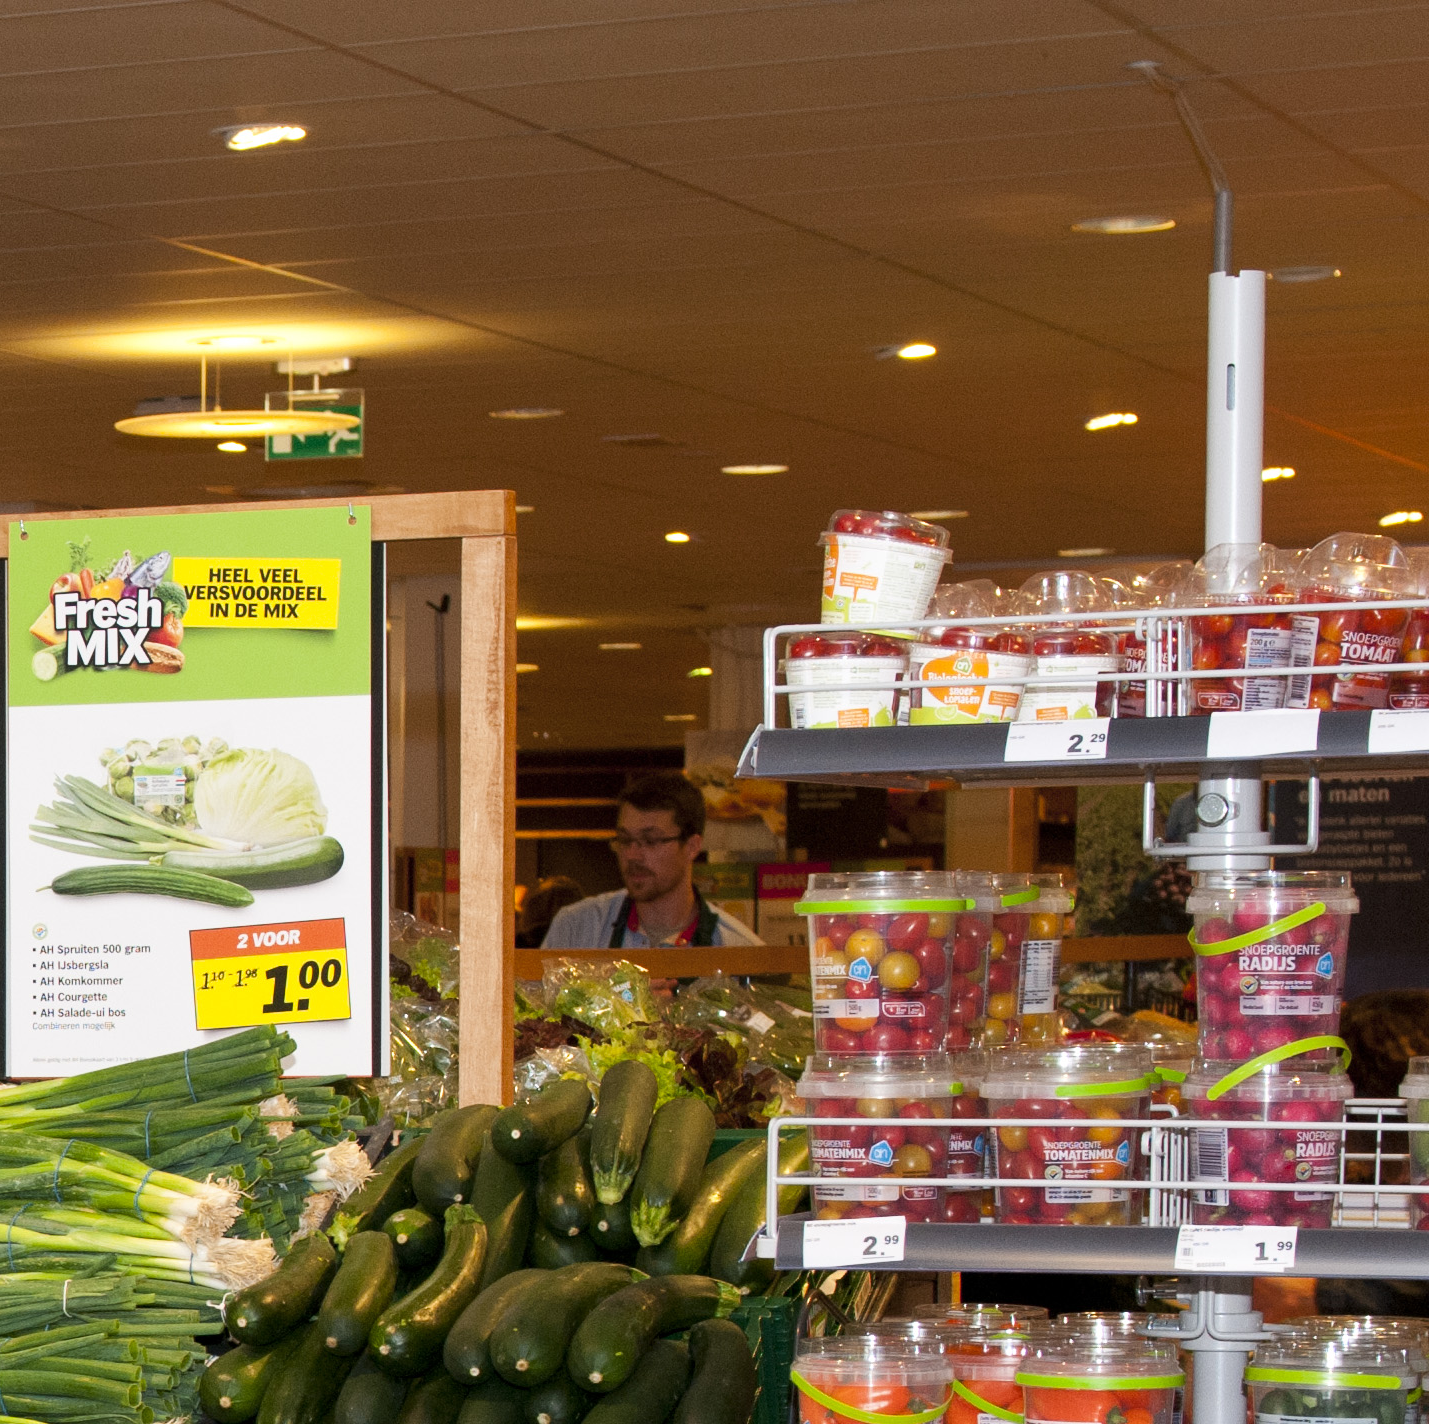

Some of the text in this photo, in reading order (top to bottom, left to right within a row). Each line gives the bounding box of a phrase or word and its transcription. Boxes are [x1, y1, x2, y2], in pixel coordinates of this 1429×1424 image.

[208, 568, 304, 583] HEEL VEEL
[184, 585, 327, 602] VERSVOORDEEL
[54, 588, 163, 630] Fresh
[209, 602, 299, 619] IN DE MIX
[67, 628, 153, 666] MIX
[1340, 642, 1397, 663] TOMAAT
[1067, 733, 1106, 753] 2.29
[1329, 786, 1390, 803] maten
[236, 929, 301, 949] 2 VOOR
[40, 944, 151, 956] AH Spruiten 500 gram
[1238, 944, 1321, 955] SNOEPGROENTE
[40, 960, 109, 971] AH IJsbergsla
[1238, 956, 1296, 971] RADIJS
[40, 976, 123, 986] AH Komkommer
[262, 958, 342, 1014] 1.00
[40, 991, 107, 1003] AH Courgette
[40, 1007, 126, 1017] AH Salade-ui bos
[32, 1022, 80, 1030] Combineren
[1043, 1149, 1114, 1161] TOMATENMIX
[1296, 1142, 1335, 1157] RADIJS
[862, 1234, 899, 1256] 2.99
[1255, 1241, 1293, 1261] 1.99
